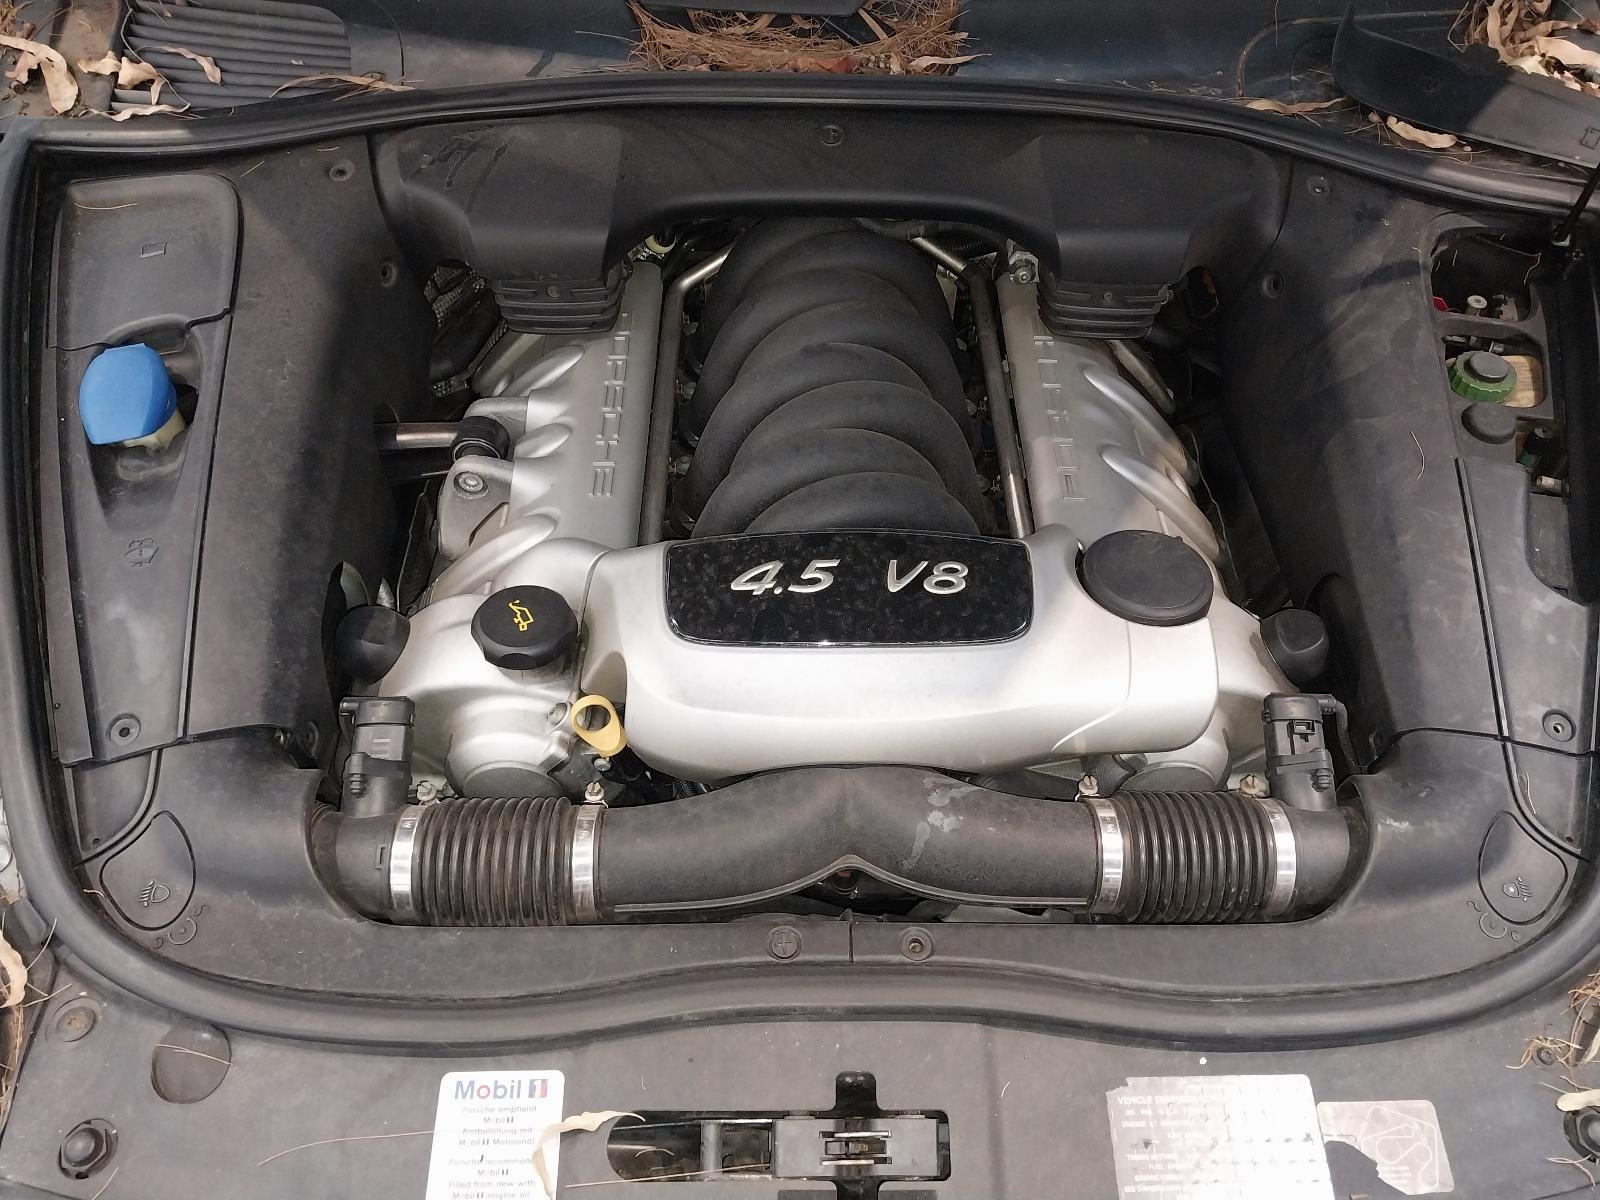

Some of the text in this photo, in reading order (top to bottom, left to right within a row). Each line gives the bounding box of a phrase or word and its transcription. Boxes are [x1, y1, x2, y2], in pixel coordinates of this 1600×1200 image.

[591, 313, 632, 496] PORSCHE
[730, 558, 969, 596] 4.5 V8
[455, 1079, 522, 1100] Mobil
